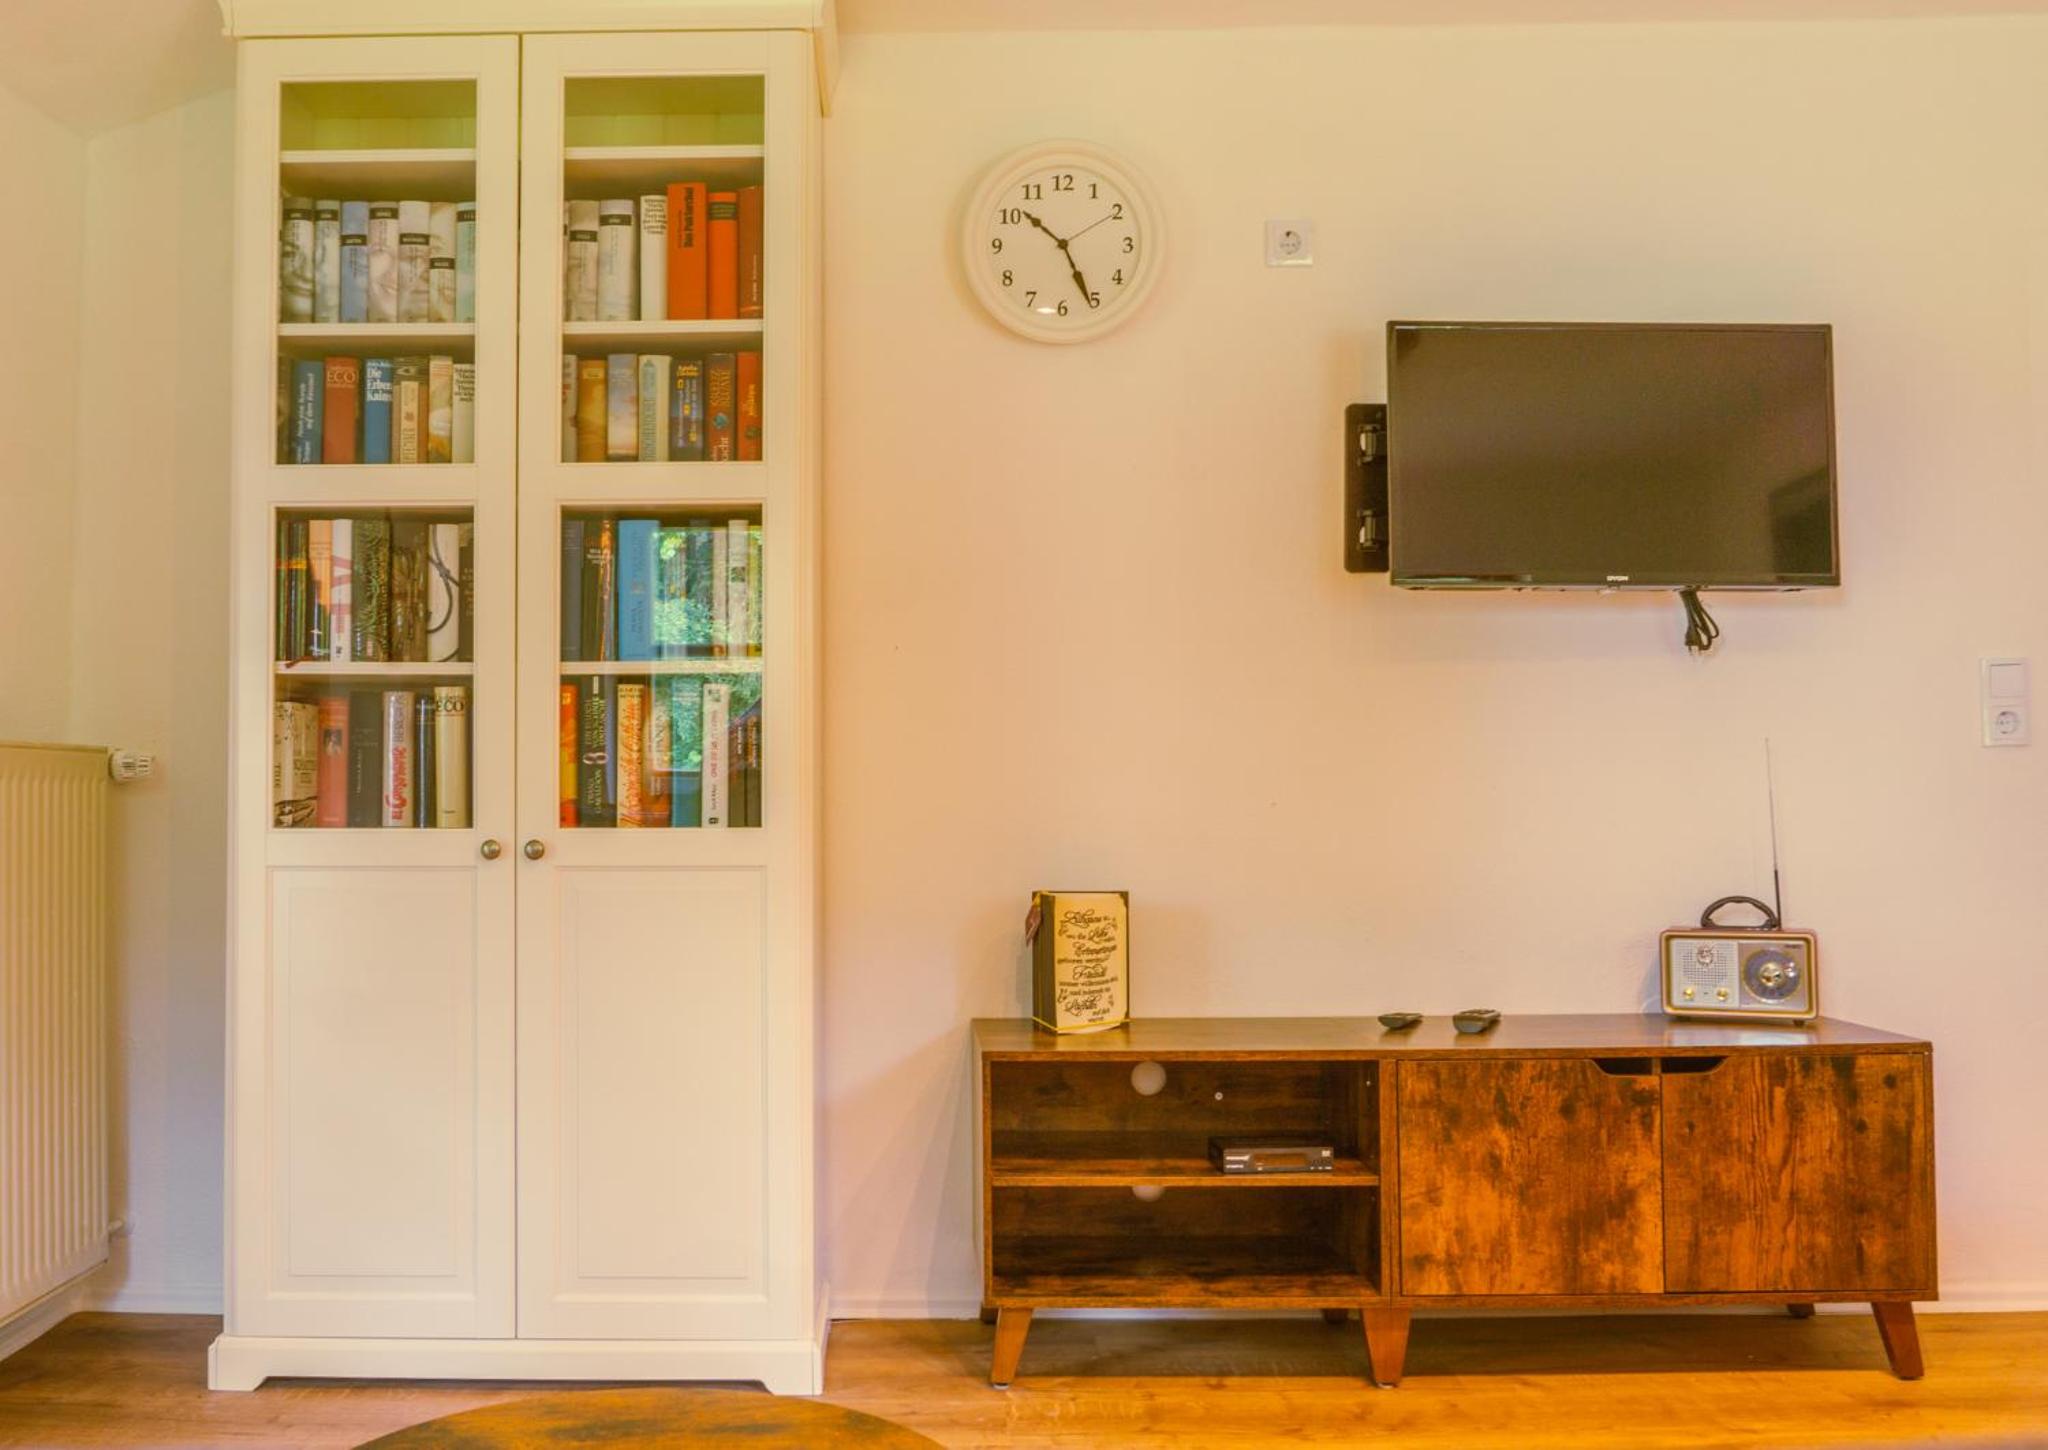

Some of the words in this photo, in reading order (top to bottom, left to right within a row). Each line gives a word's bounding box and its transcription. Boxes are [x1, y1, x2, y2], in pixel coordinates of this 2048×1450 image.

[1052, 174, 1074, 191] 12
[1022, 184, 1043, 200] 11
[1088, 183, 1098, 199] 1
[999, 208, 1021, 225] 10
[1111, 203, 1123, 220] 2
[991, 238, 1003, 254] 9
[1122, 237, 1134, 253] 3
[1002, 270, 1013, 286] 8
[1112, 268, 1124, 285] 4
[1025, 291, 1037, 308] 7
[1089, 292, 1100, 308] 5
[1057, 300, 1068, 316] 6
[326, 371, 356, 384] ECO
[435, 699, 464, 712] ECO
